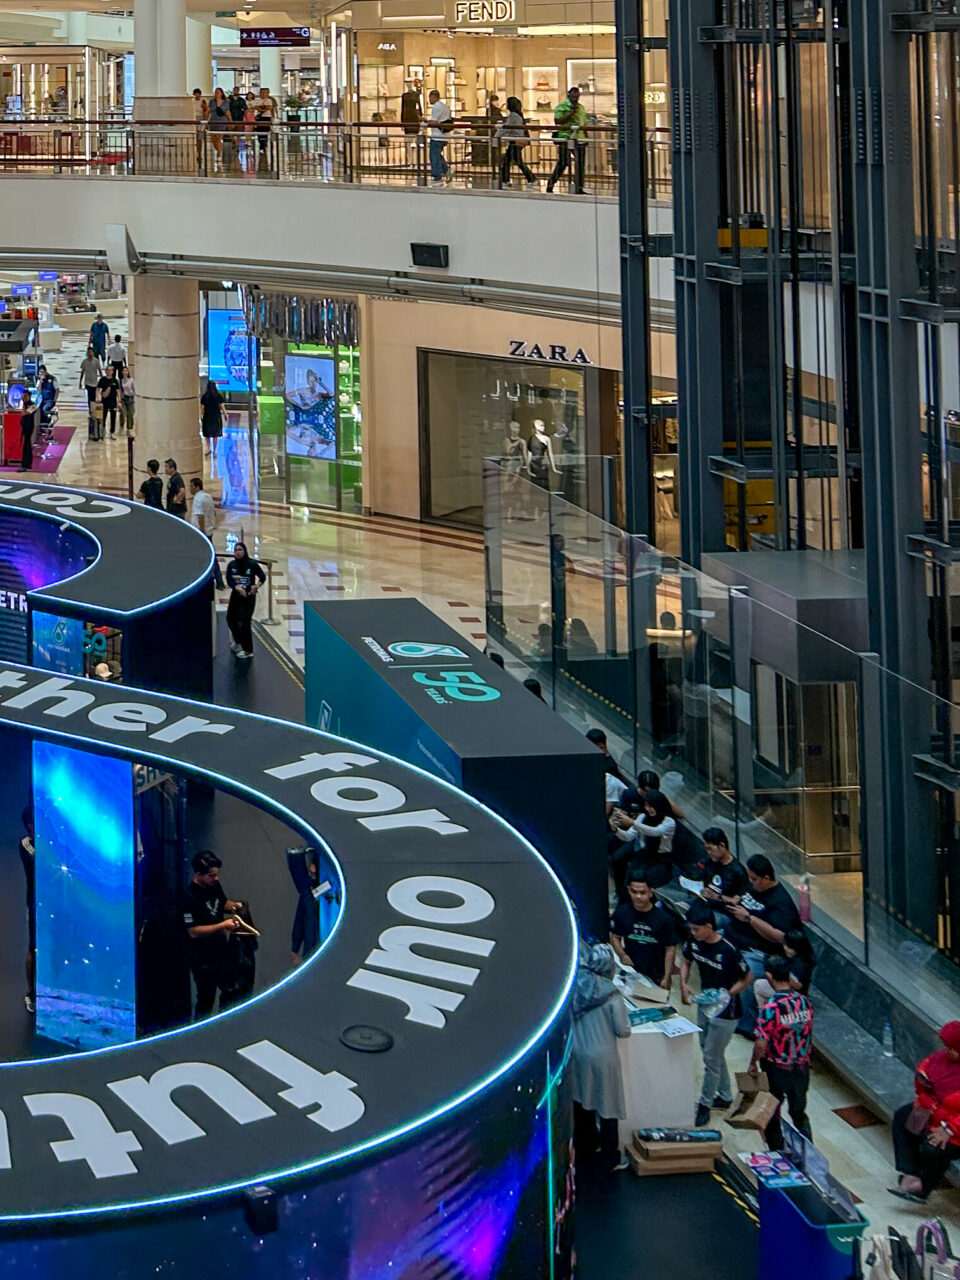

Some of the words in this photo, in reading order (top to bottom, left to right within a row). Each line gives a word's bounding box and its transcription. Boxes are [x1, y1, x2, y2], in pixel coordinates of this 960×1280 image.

[455, 0, 516, 23] FENDI
[300, 27, 310, 37] G
[509, 340, 594, 365] ZARA
[412, 671, 502, 702] 50
[264, 751, 469, 835] for
[346, 874, 496, 1028] our
